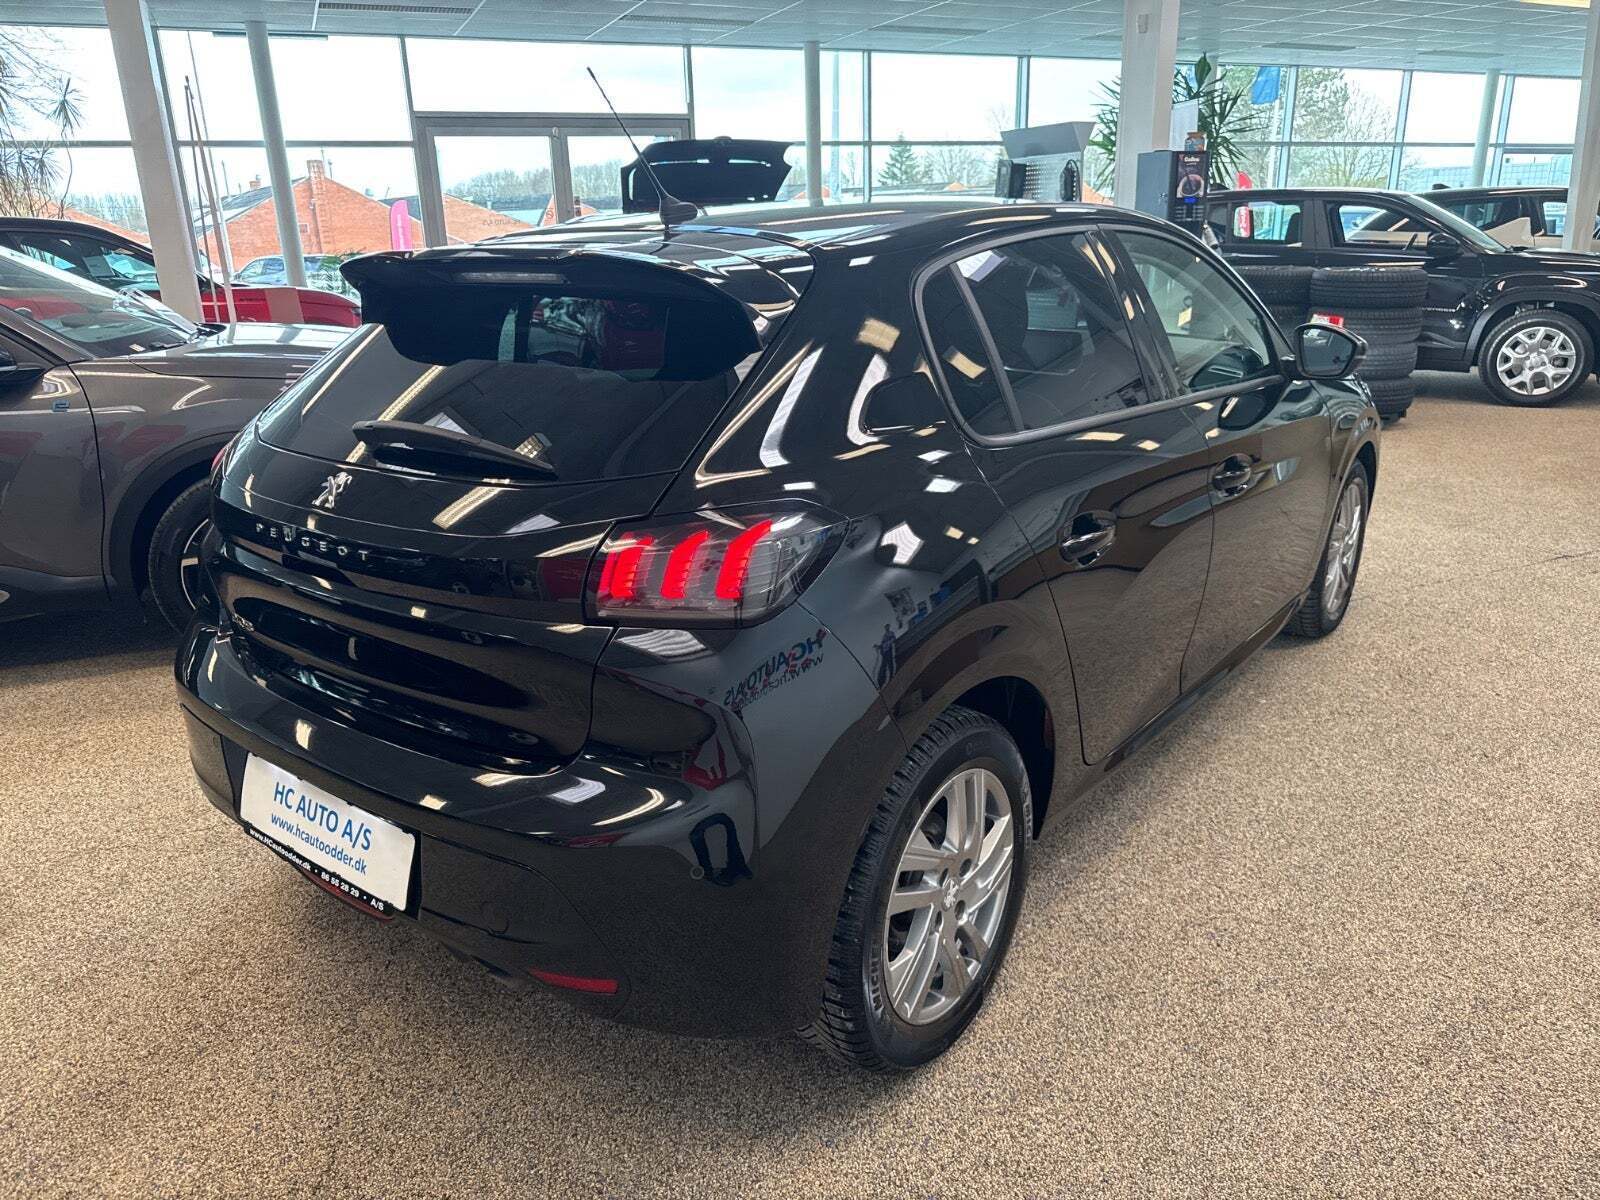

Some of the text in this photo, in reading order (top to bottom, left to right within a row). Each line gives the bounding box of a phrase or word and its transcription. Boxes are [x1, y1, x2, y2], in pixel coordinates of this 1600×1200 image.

[255, 522, 369, 562] PEUGEOT
[273, 781, 372, 852] HC AUTO A/S
[270, 812, 368, 876] www.hcautoodder.dk
[350, 887, 360, 898] 29
[370, 898, 385, 911] A/S
